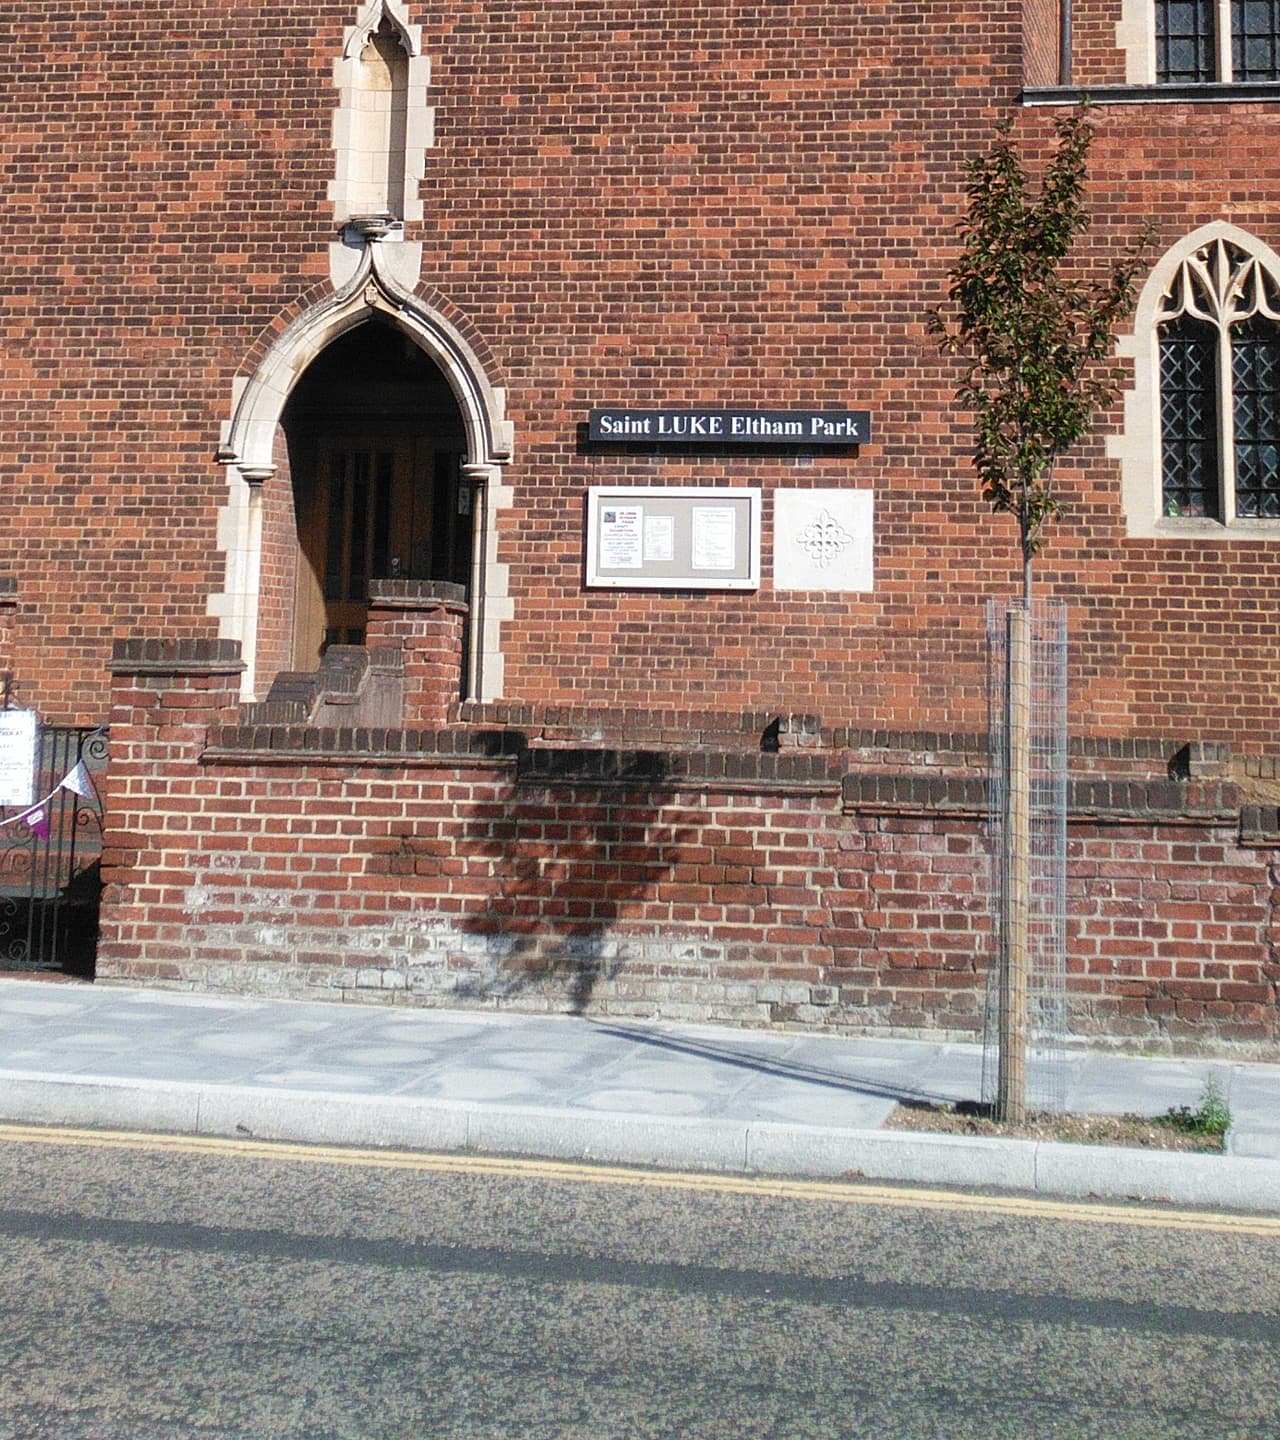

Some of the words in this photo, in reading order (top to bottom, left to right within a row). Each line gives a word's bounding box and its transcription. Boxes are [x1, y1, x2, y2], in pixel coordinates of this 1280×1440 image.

[599, 415, 651, 435] Saint
[658, 416, 723, 435] LUKE
[731, 416, 803, 436] Eltham
[810, 417, 859, 437] Park
